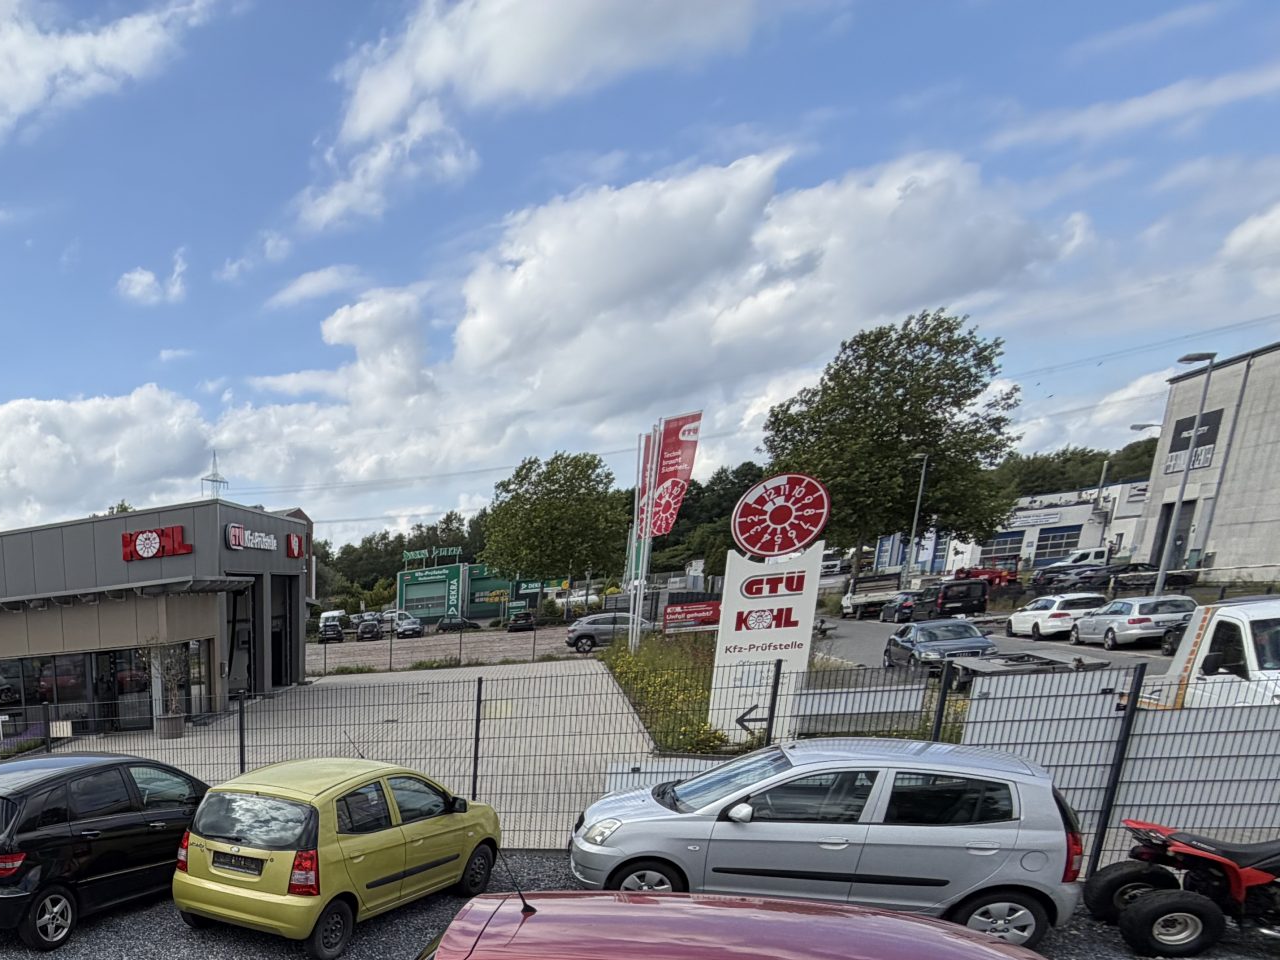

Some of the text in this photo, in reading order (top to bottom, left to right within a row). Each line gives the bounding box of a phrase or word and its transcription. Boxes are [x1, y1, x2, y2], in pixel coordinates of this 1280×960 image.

[762, 489, 777, 502] 12
[780, 484, 790, 495] 11
[791, 485, 805, 498] 10
[744, 571, 806, 596] GTÜ
[449, 579, 458, 605] DEKRA
[724, 641, 804, 654] Kfz-Prüfstelle
